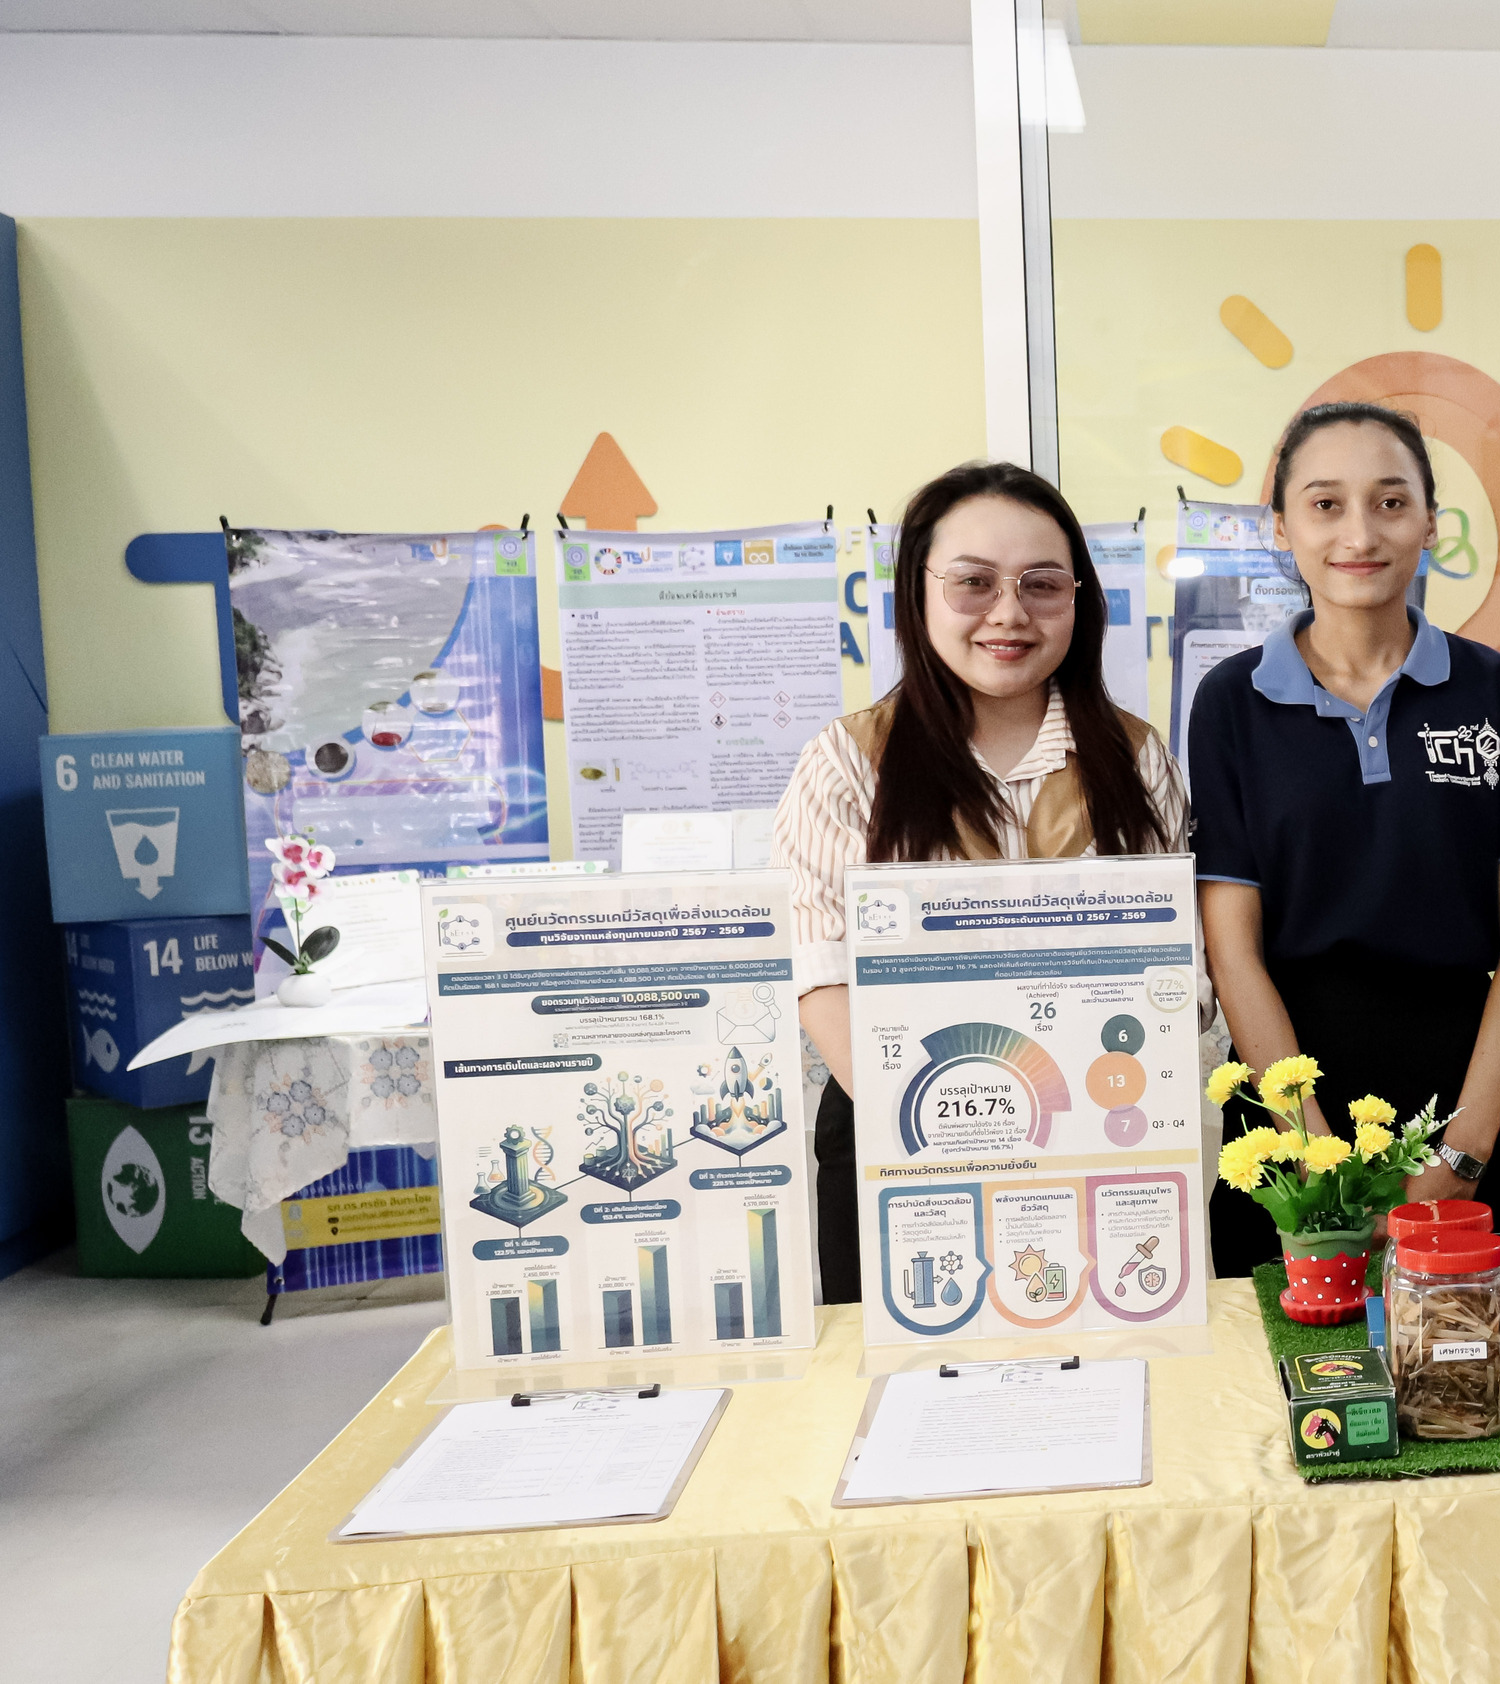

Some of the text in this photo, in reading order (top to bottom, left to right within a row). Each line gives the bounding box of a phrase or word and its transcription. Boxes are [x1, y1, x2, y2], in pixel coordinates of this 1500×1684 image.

[55, 750, 184, 791] 6 CLEAN WATER
[93, 770, 206, 790] AND SANITATION
[921, 890, 1174, 915] ศูนย์นวัตกรรมเคมีวัสดุเพื่อสิ่งแวดล้อม
[505, 904, 771, 932] ศูนย์นวัตกรรมเคมีวัสดุเพื่อสิ่งแวดล้อม
[955, 914, 1073, 926] บทความวิจัยระดับนานาชาติ
[1087, 913, 1110, 921] 2567
[1122, 911, 1146, 920] 2569
[193, 934, 218, 951] LIFE
[540, 926, 679, 944] ทุนวิจัยจากแหล่งทุนภายนอกปี
[683, 928, 707, 936] 2567
[719, 926, 745, 935] 2569
[143, 938, 183, 976] 14
[195, 953, 238, 972] BELOW
[1156, 979, 1184, 990] 77%
[541, 995, 619, 1007] ยอดรวมทุนวิจัยสะสม
[621, 992, 682, 1004] 10,088,500
[1026, 991, 1059, 1000] (Achieved)
[1091, 989, 1124, 997] (Quartile)
[639, 1013, 665, 1021] 168.1%
[1029, 1002, 1056, 1020] 26
[1034, 1021, 1053, 1033] เรื่อง
[1118, 1024, 1171, 1043] 6 Q1
[878, 1033, 903, 1042] (Target)
[881, 1044, 902, 1058] 12
[454, 1056, 594, 1074] เส้นทางการเติบโตและผลงานรายปี
[882, 1059, 901, 1071] เรื่อง
[1107, 1070, 1173, 1088] 13 Q2
[940, 1083, 1011, 1098] บรรลุเป้าหมาย
[937, 1098, 1015, 1118] 216.7%
[1121, 1120, 1130, 1132] 7
[1152, 1119, 1164, 1129] Q3
[1172, 1118, 1185, 1128] Q4
[880, 1159, 1037, 1177] ทิศทางนวัตกรรมเพื่อความยั่งยืน
[190, 1156, 206, 1200] ACTION
[995, 1192, 1074, 1204] พลังงานทดแทนและ
[1101, 1187, 1172, 1197] นวัตกรรมสมุนไพร
[888, 1197, 972, 1209] การบำบัดสิ่งแวดล้อม
[1115, 1198, 1158, 1208] และสุขภาพ
[914, 1209, 946, 1218] และวัสดุ
[1439, 1345, 1481, 1357] เศษกระจูด
